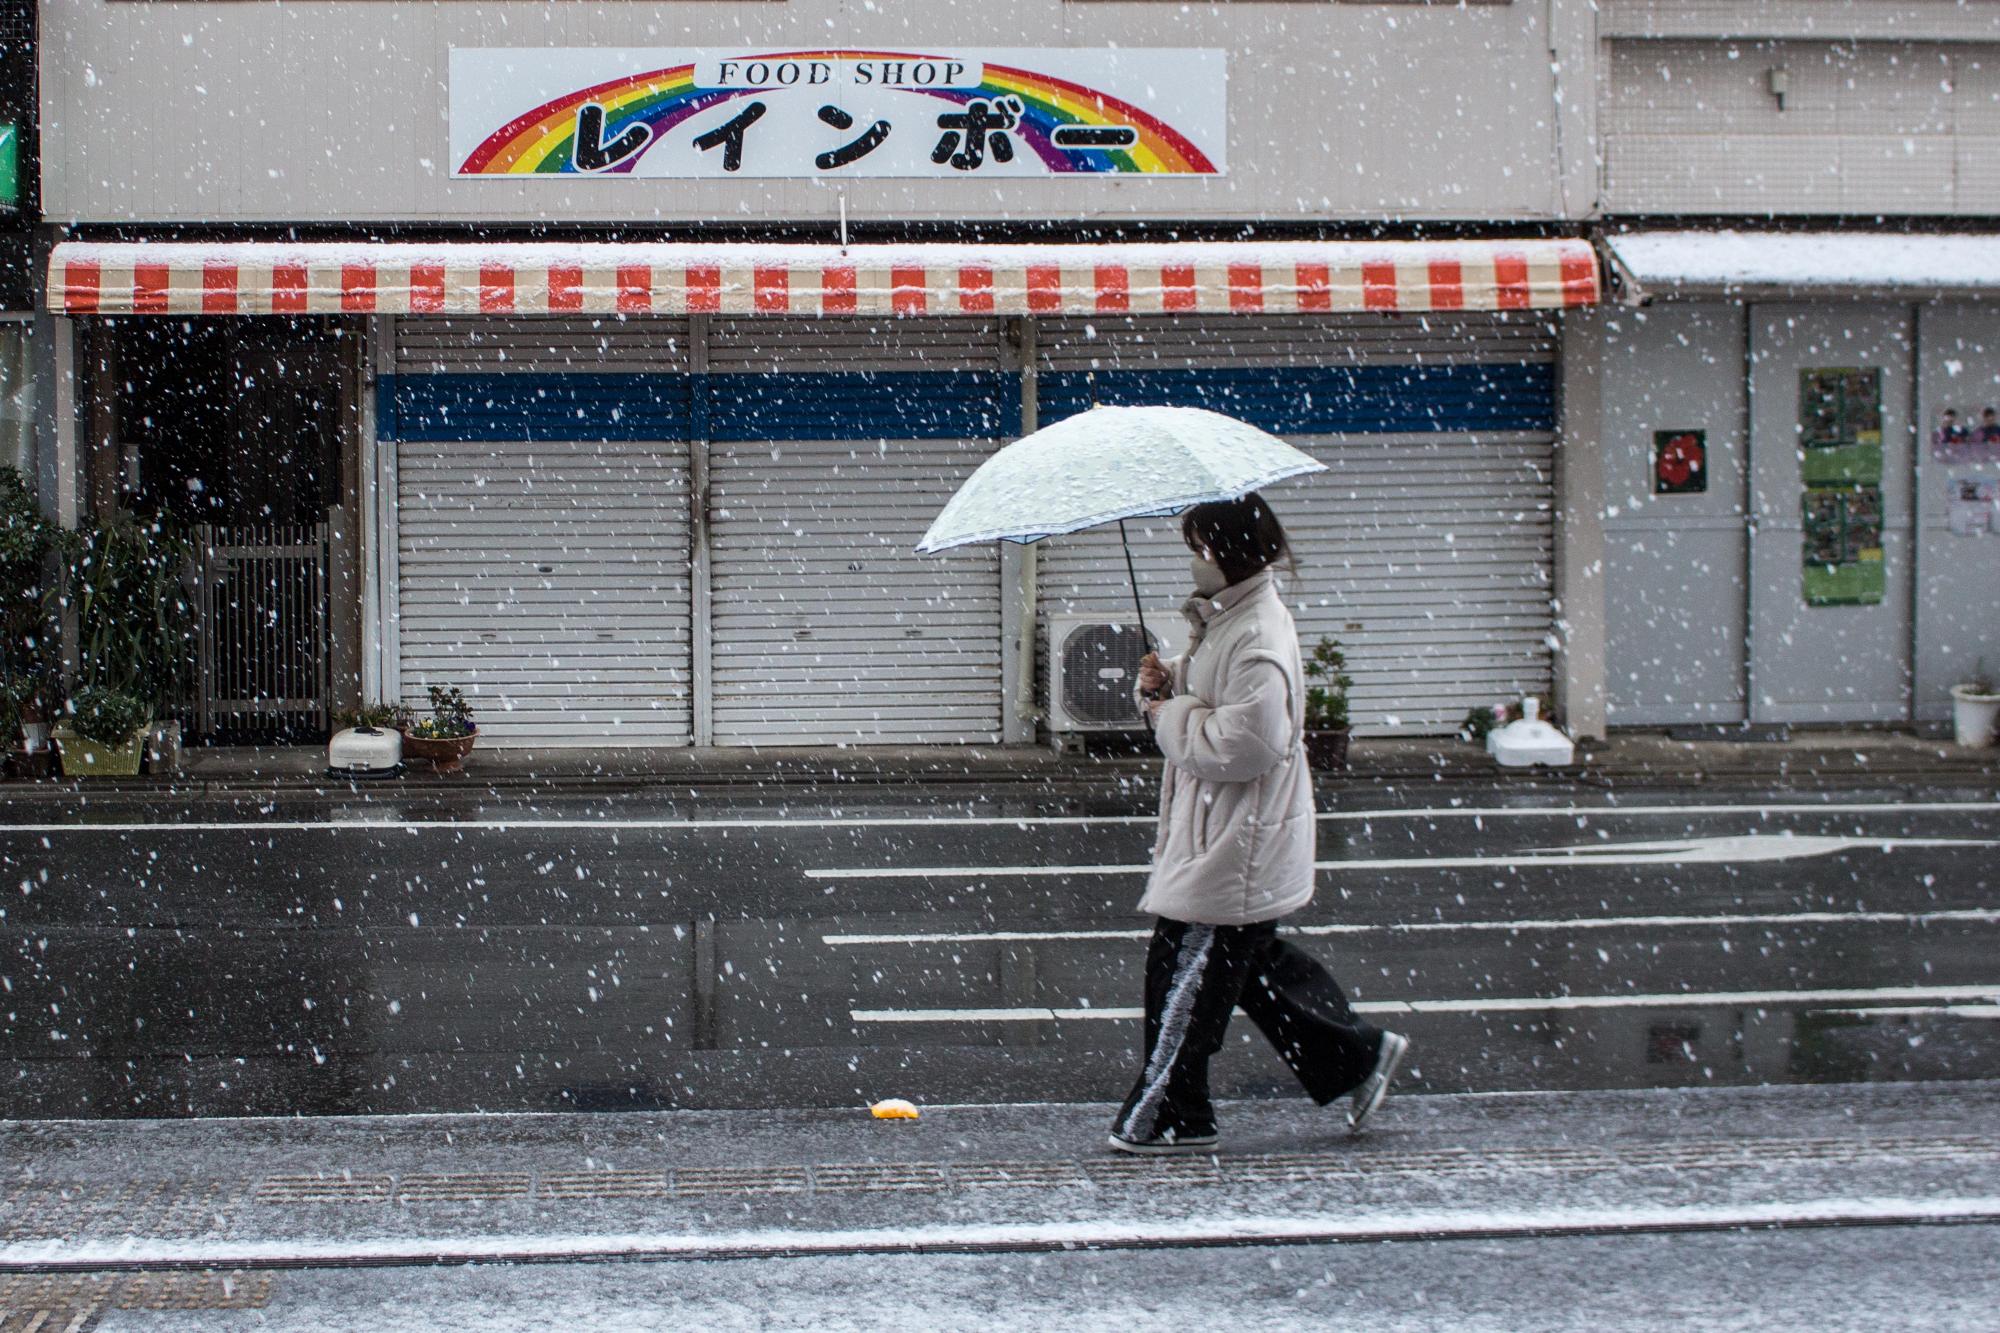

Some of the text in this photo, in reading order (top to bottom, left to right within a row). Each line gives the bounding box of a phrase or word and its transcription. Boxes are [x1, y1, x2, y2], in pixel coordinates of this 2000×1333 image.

[717, 62, 965, 85] FOOD SHOP
[575, 97, 1136, 172] レインボー
